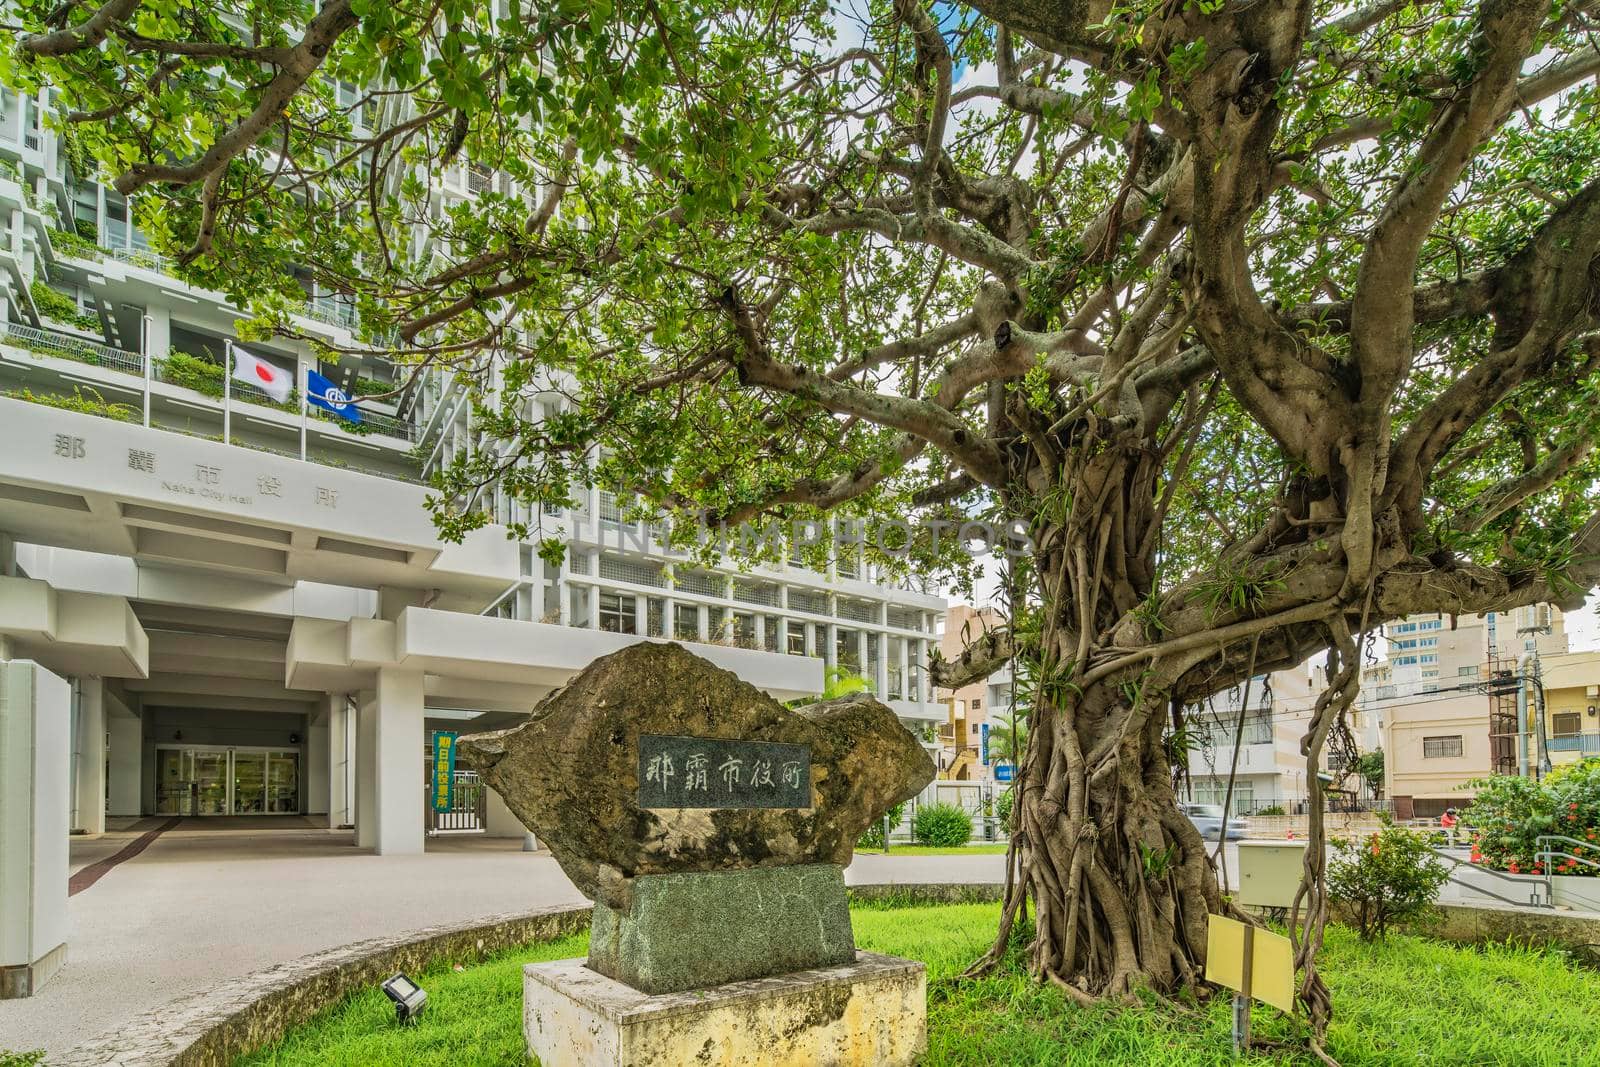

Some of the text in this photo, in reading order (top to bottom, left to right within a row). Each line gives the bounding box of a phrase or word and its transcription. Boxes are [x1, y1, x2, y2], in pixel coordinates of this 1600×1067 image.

[161, 481, 253, 505] Naha City Hall
[436, 736, 452, 808] 期日前投票所
